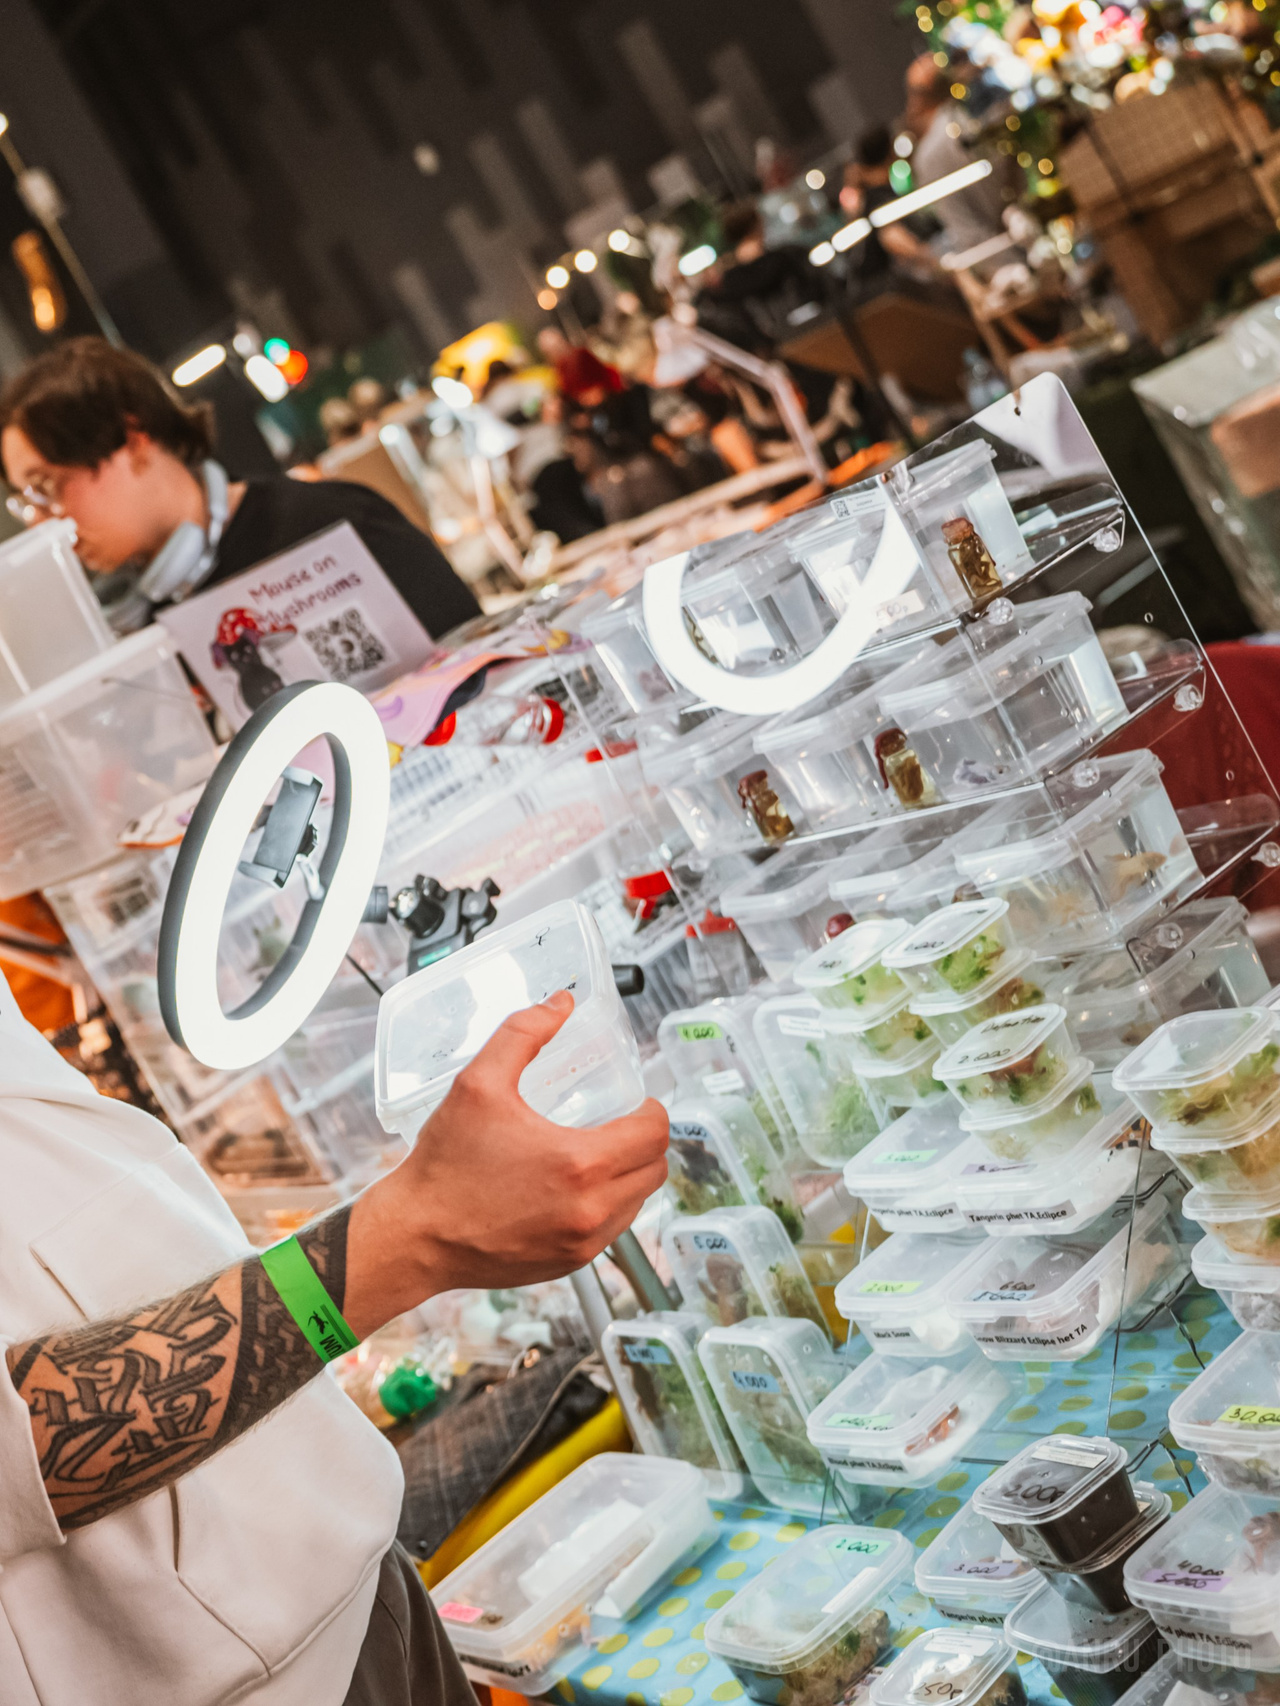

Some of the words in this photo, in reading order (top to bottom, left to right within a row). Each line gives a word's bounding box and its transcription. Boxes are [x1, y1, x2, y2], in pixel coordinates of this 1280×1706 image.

[248, 569, 312, 604] Mouse
[313, 556, 336, 574] on
[256, 571, 362, 628] Mushrooms
[969, 1213, 1005, 1222] Tangerin
[1006, 1212, 1023, 1222] phet
[995, 1335, 1027, 1344] Blizzard
[1027, 1336, 1056, 1346] Eclipse
[1058, 1333, 1075, 1344] het
[1074, 1323, 1088, 1336] TA
[941, 1610, 977, 1623] Tangerin
[978, 1614, 997, 1625] phet
